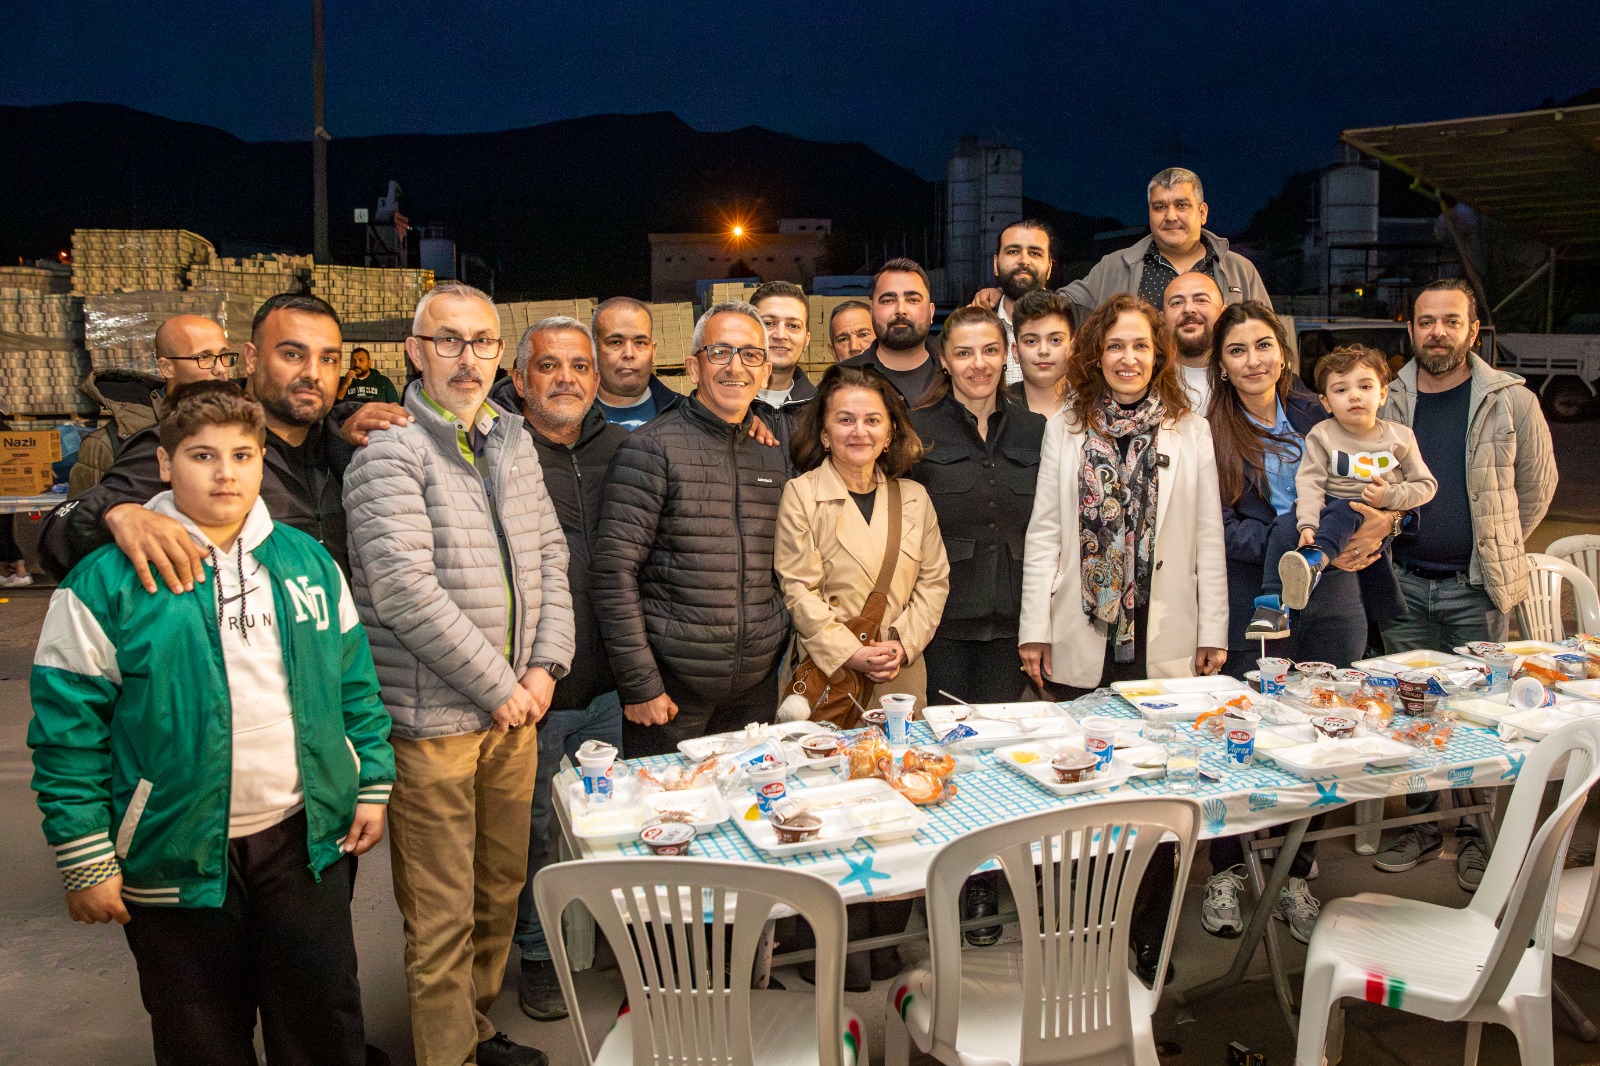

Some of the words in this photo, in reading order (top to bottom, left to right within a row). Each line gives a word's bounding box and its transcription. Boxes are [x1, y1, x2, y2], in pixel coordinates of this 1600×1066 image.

[3, 437, 37, 448] Nazlı
[228, 612, 273, 631] RUN
[1228, 743, 1250, 755] Ayran
